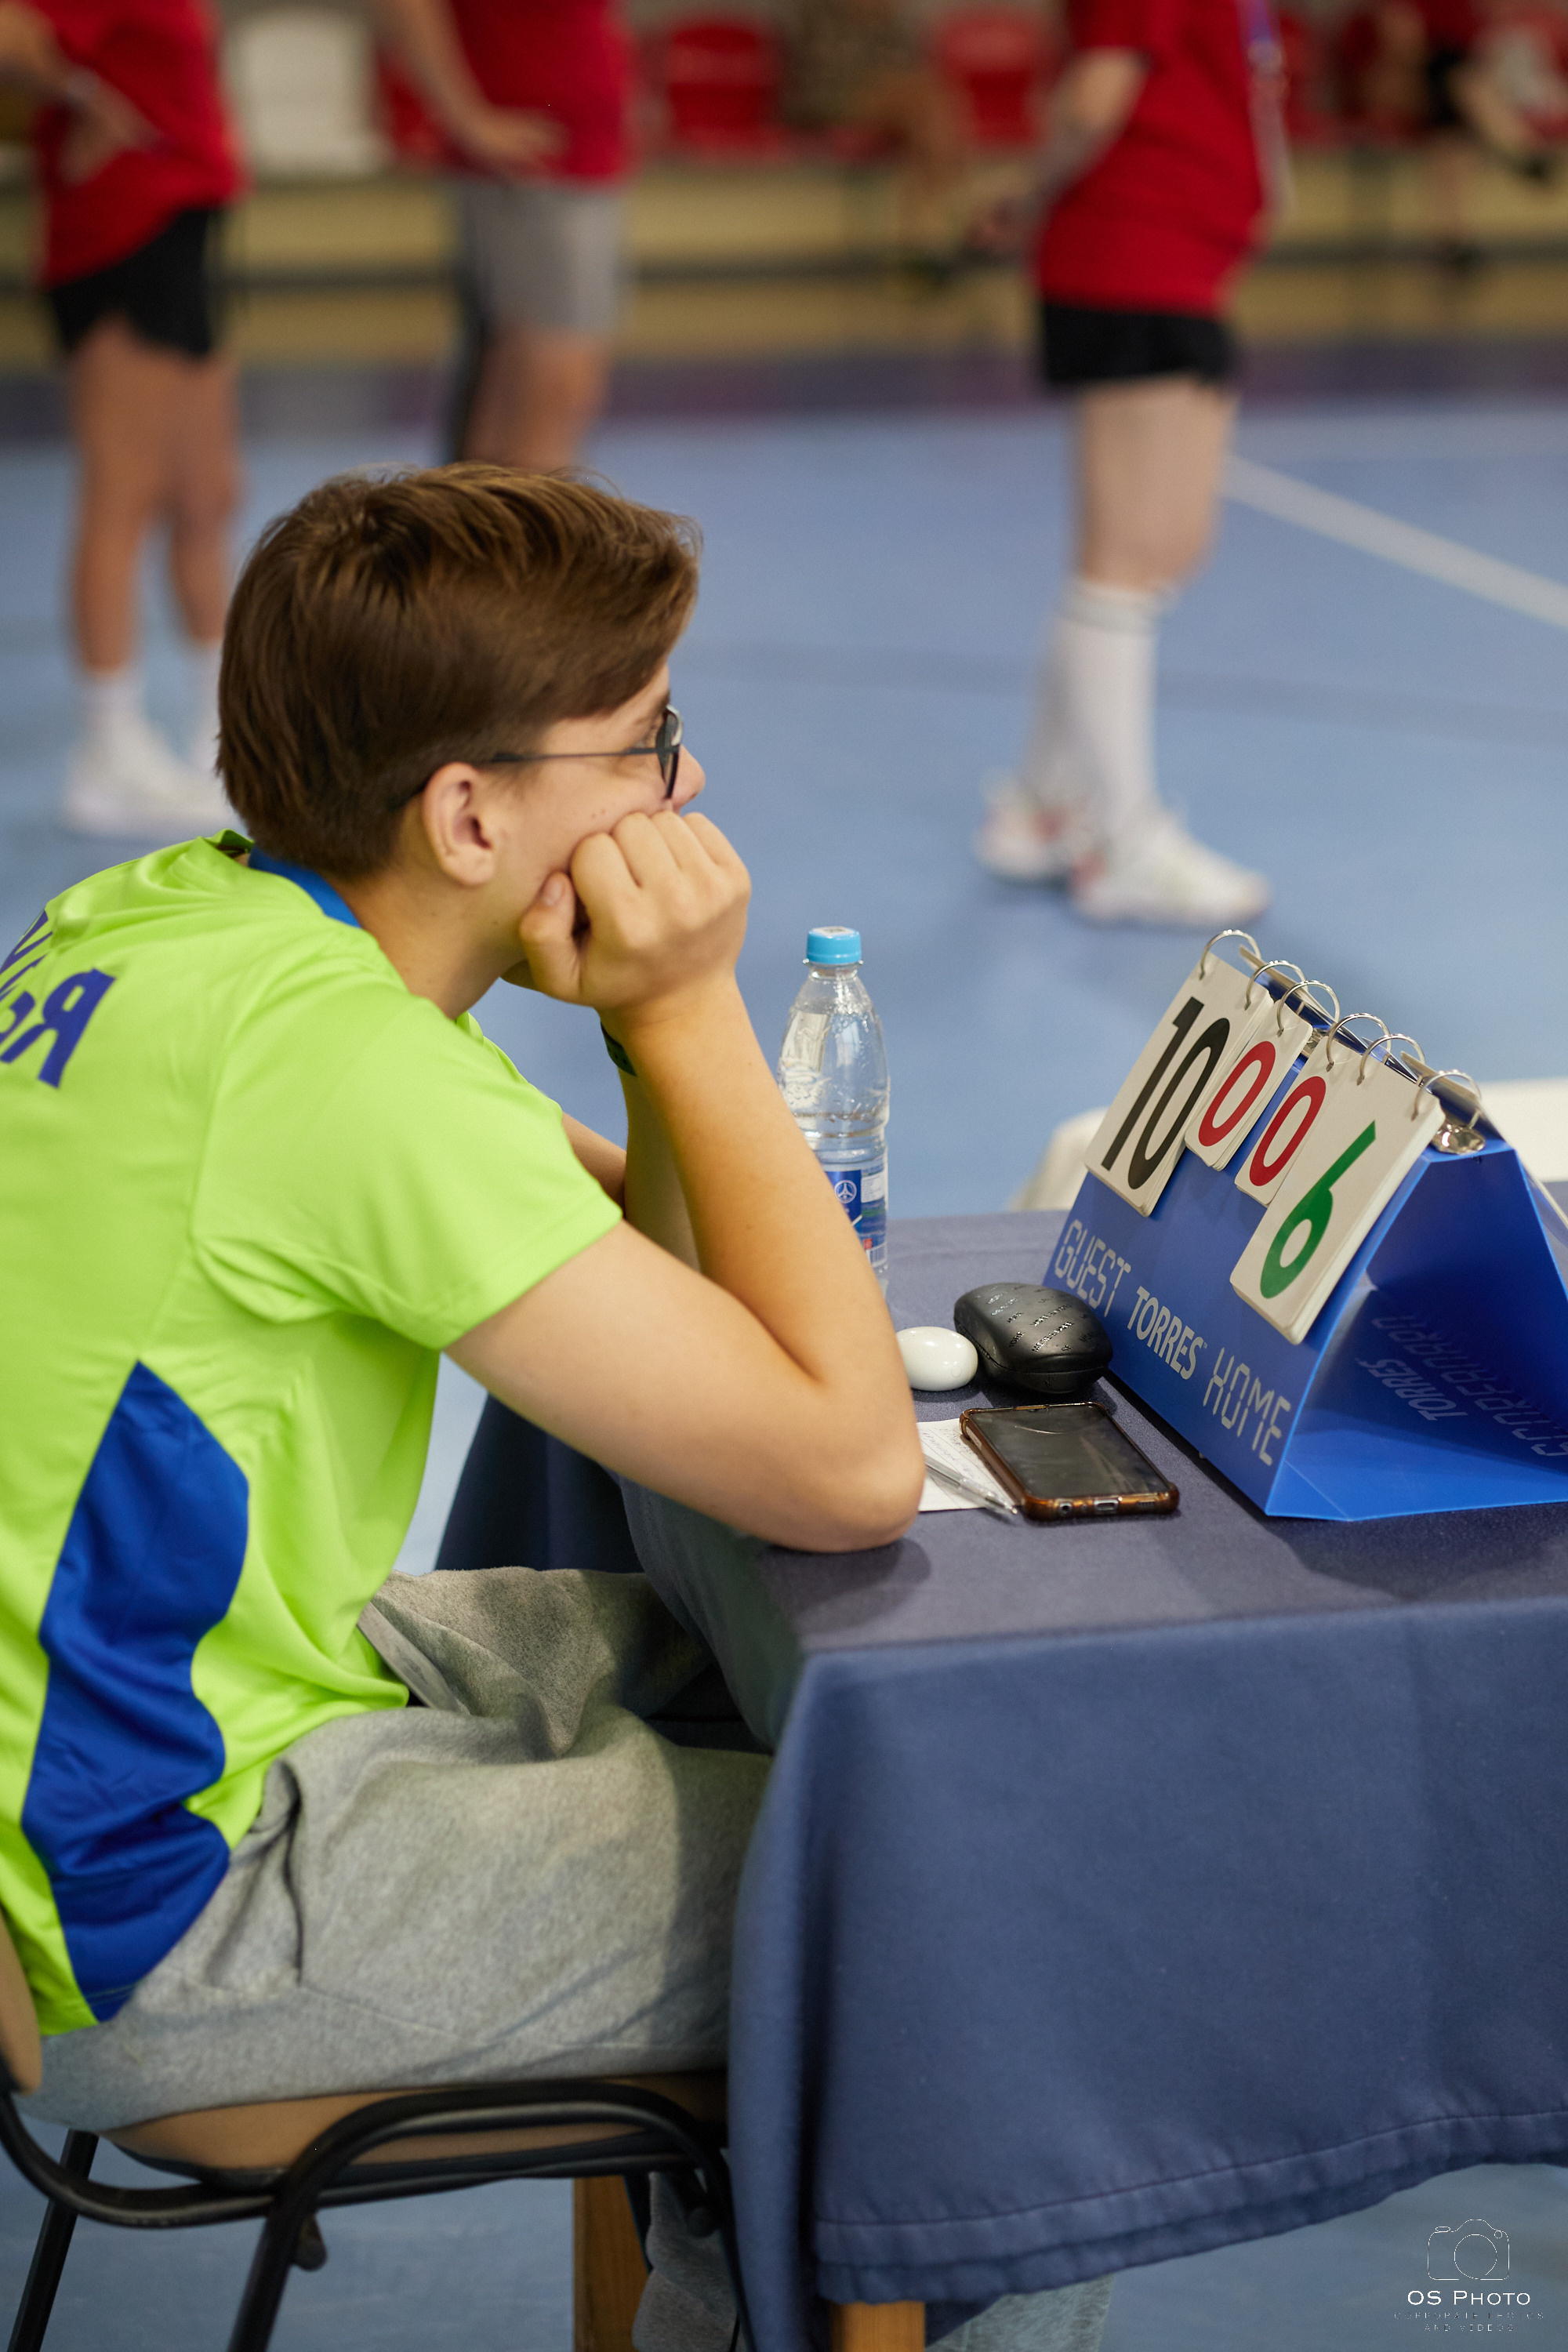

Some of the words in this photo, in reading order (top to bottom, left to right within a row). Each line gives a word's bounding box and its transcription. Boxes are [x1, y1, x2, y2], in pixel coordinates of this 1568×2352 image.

[1102, 996, 1231, 1190] 10
[1198, 1040, 1276, 1147] 0
[1249, 1076, 1327, 1187] 0
[1259, 1120, 1376, 1299] 6
[1054, 1219, 1131, 1318] GUEST
[1127, 1286, 1205, 1380] TORRES
[1203, 1347, 1292, 1466] HOME
[1356, 1359, 1468, 1421] TORRES
